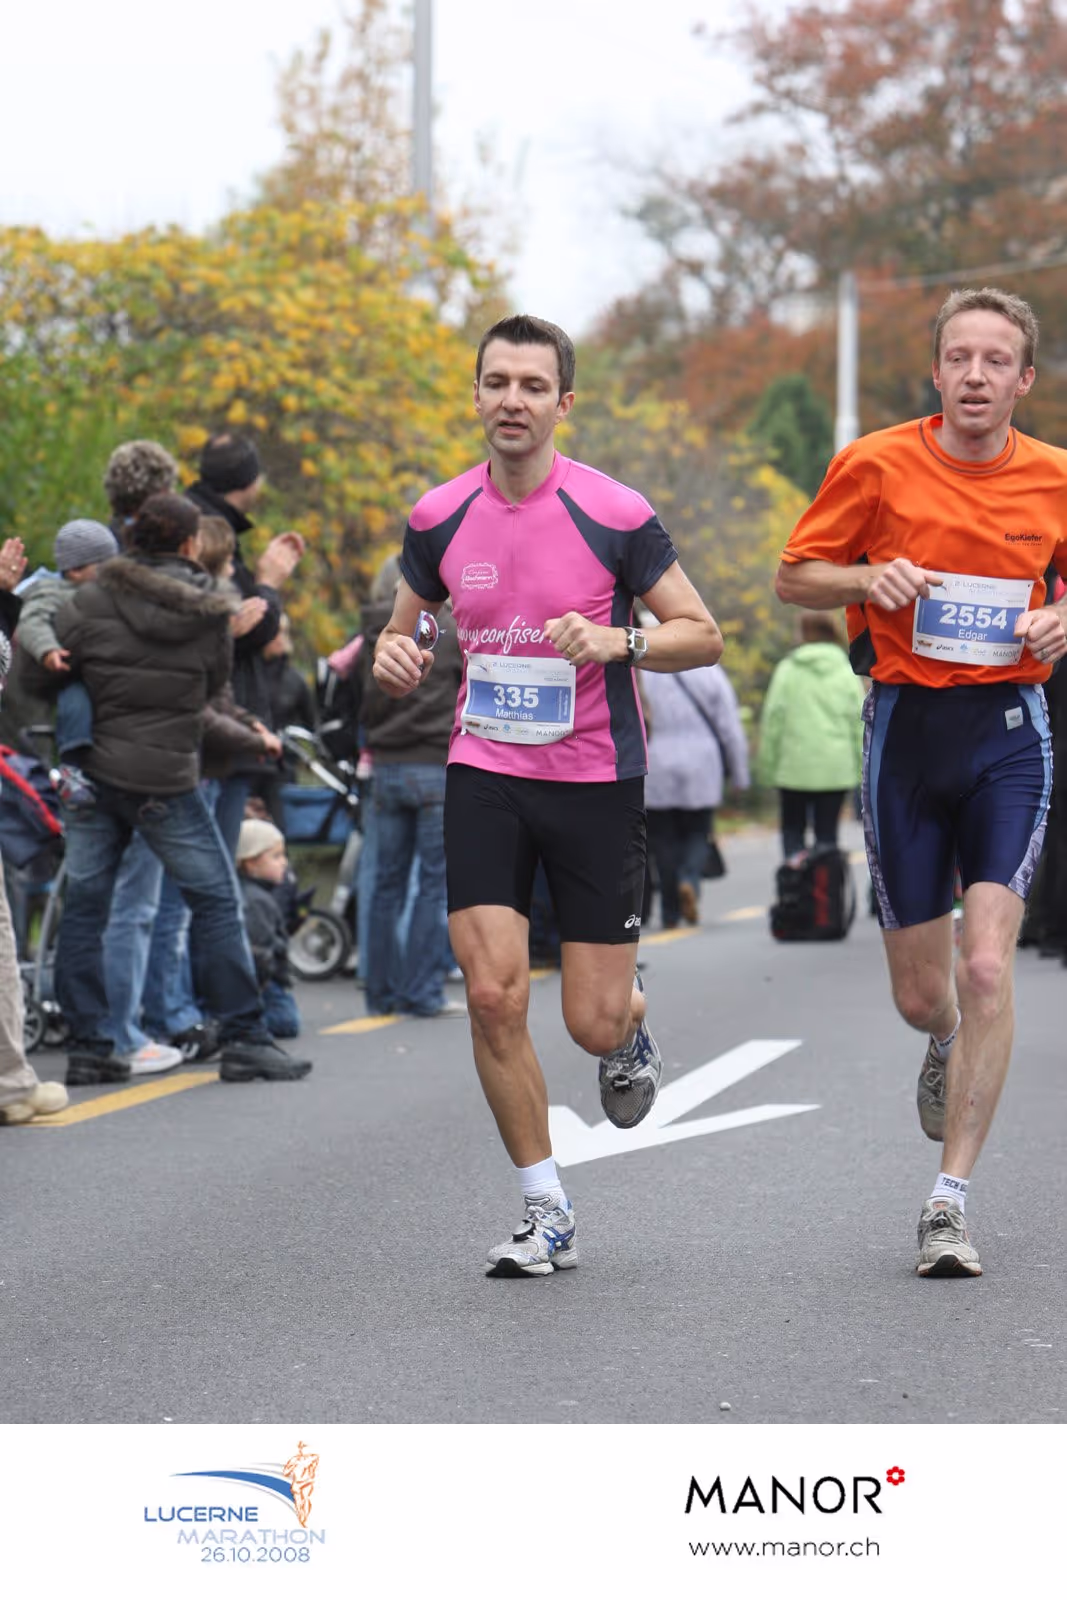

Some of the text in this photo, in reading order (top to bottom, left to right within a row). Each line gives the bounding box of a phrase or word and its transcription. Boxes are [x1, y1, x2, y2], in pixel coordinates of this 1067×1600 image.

[1004, 533, 1043, 542] EgoKiefer
[939, 603, 1008, 630] 2554
[958, 628, 988, 642] Edgar
[493, 684, 539, 709] 335
[495, 707, 534, 721] Matthias
